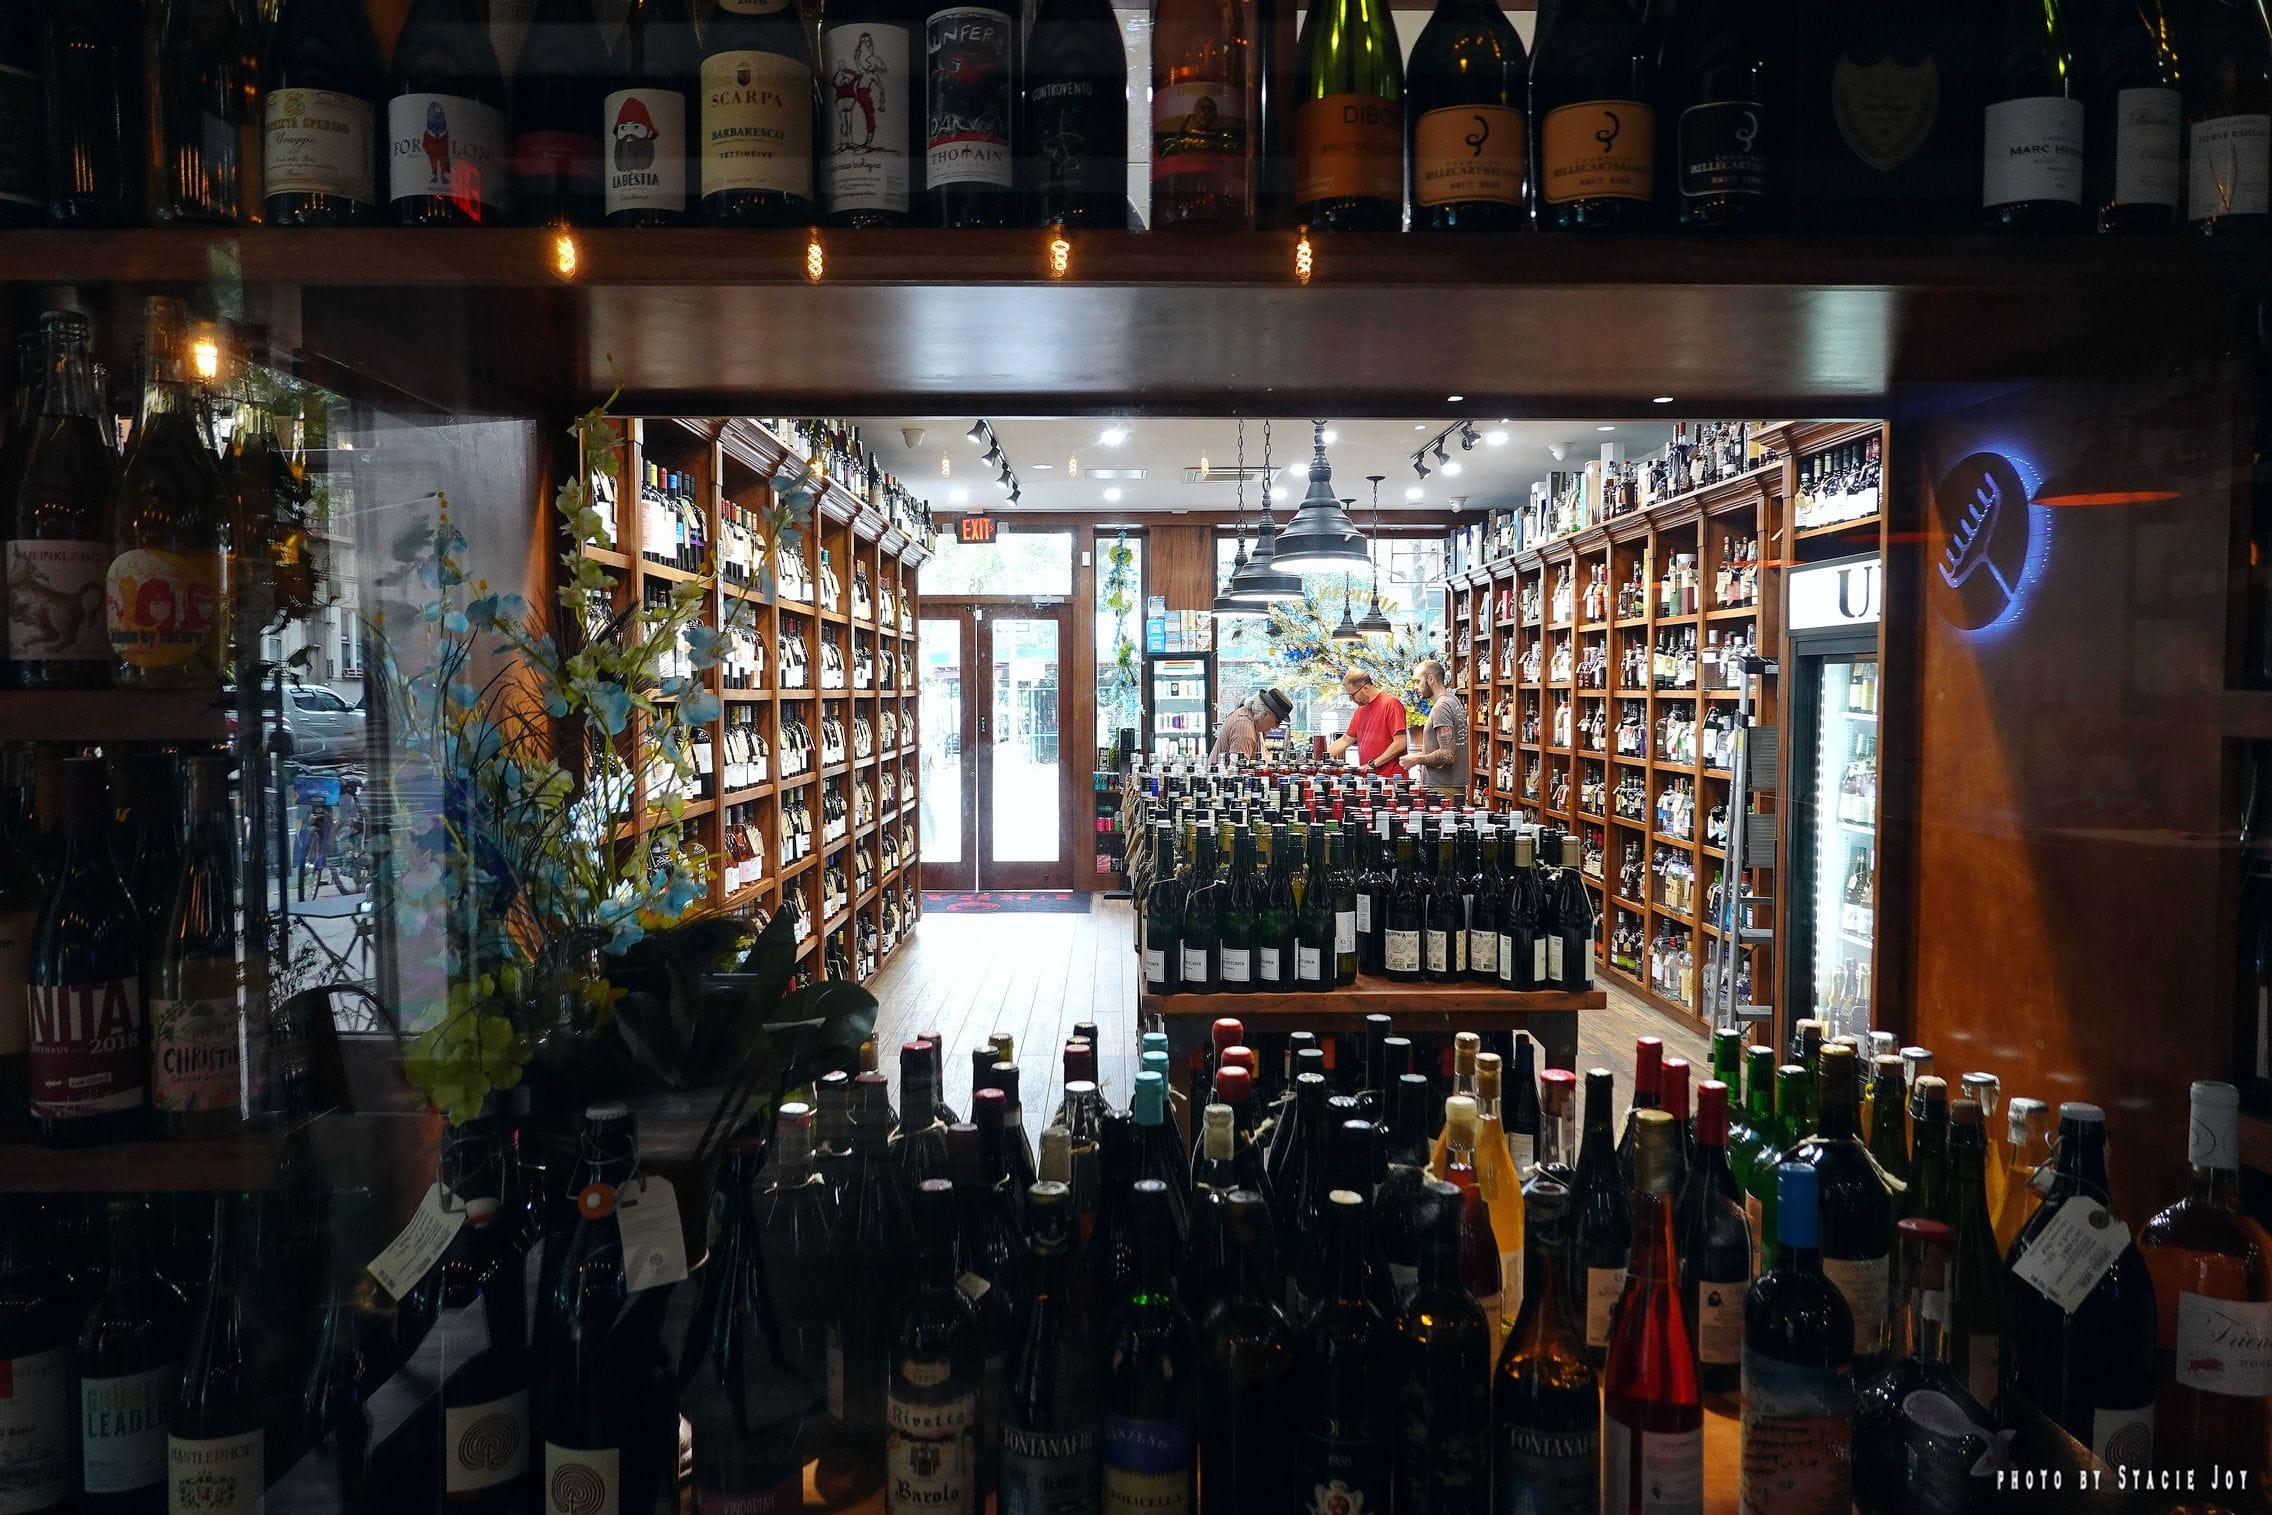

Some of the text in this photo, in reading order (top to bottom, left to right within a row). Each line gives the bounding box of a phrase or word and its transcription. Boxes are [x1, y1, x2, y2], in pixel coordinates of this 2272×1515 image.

[712, 91, 782, 107] SCARPA
[711, 127, 784, 141] BARBARESCO
[394, 138, 422, 158] FOR
[2009, 144, 2050, 157] MARC
[962, 518, 990, 540] EXIT
[1837, 565, 1881, 618] U
[89, 1031, 139, 1054] 2018
[890, 1404, 965, 1428] Rivetto
[896, 1477, 960, 1504] Barolo
